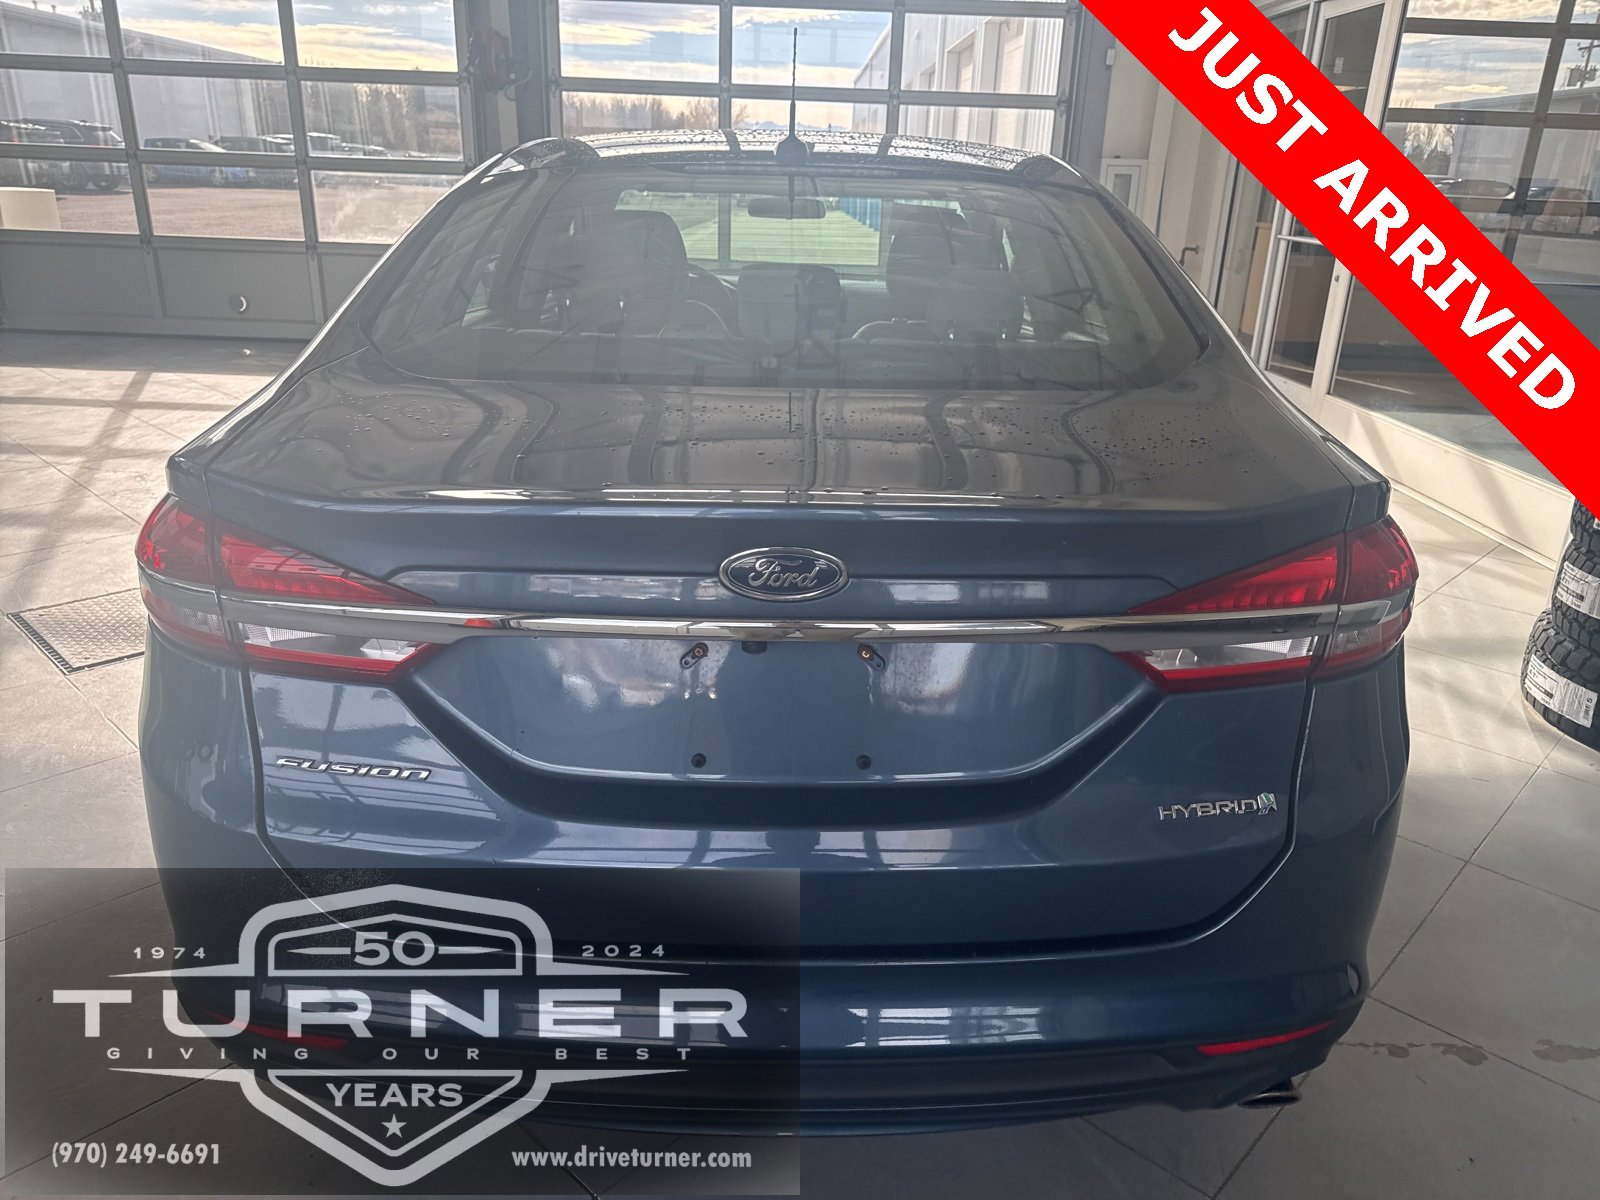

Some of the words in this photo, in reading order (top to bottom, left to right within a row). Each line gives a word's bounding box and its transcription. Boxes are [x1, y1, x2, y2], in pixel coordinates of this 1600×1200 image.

[748, 558, 820, 588] Ford
[276, 755, 432, 781] FUSION
[1158, 799, 1258, 820] HYBRID
